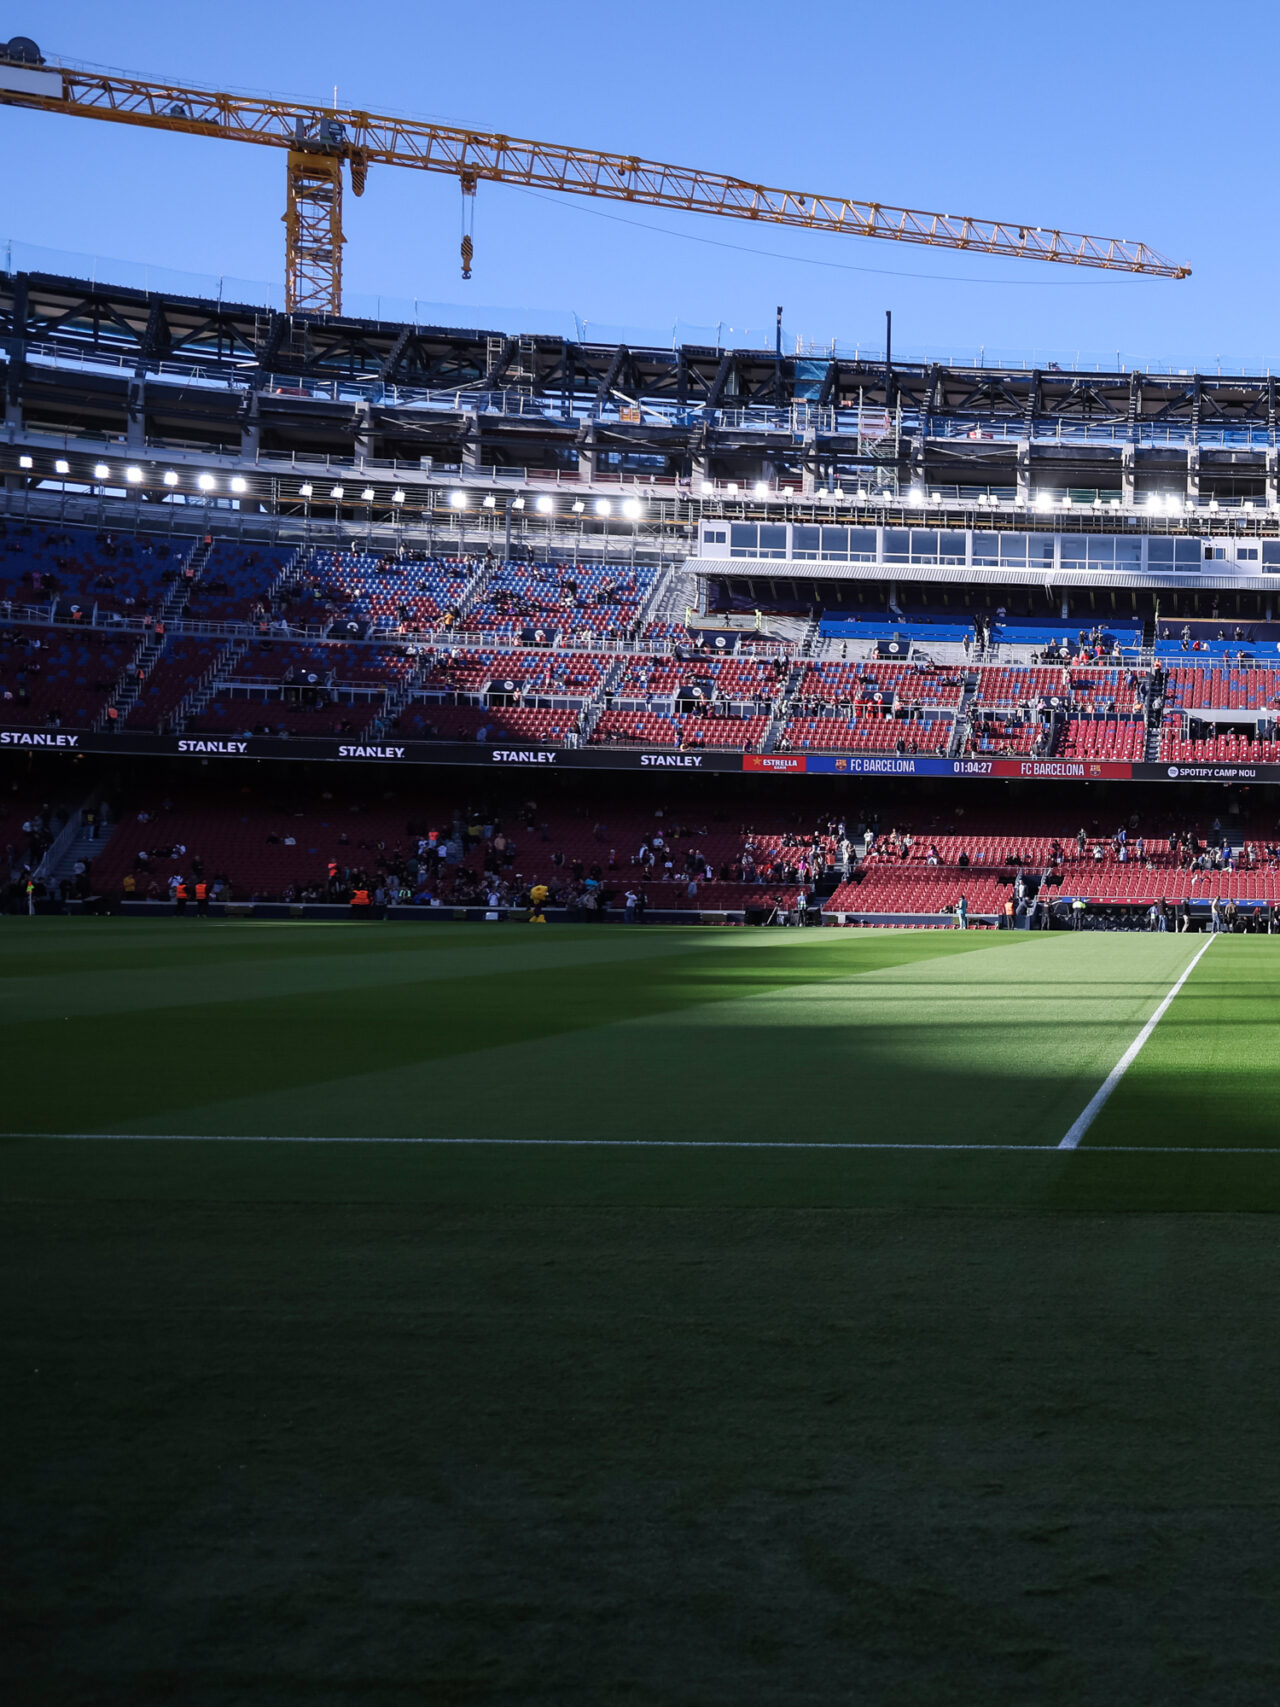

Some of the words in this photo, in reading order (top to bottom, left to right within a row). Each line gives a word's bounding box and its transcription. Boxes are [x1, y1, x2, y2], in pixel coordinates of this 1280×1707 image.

[0, 732, 78, 747] STANLEY
[178, 740, 248, 754] STANLEY
[338, 746, 405, 759] STANLEY
[492, 751, 556, 764] STANLEY
[640, 755, 702, 768] STANLEY
[850, 759, 861, 771] FC
[863, 760, 915, 772] BARCELONA
[953, 761, 992, 773] 01:04:27
[1021, 762, 1032, 775] FC
[1033, 763, 1084, 776] BARCELONA
[1180, 768, 1212, 776] SPOTIFY
[1238, 769, 1255, 777] NOU
